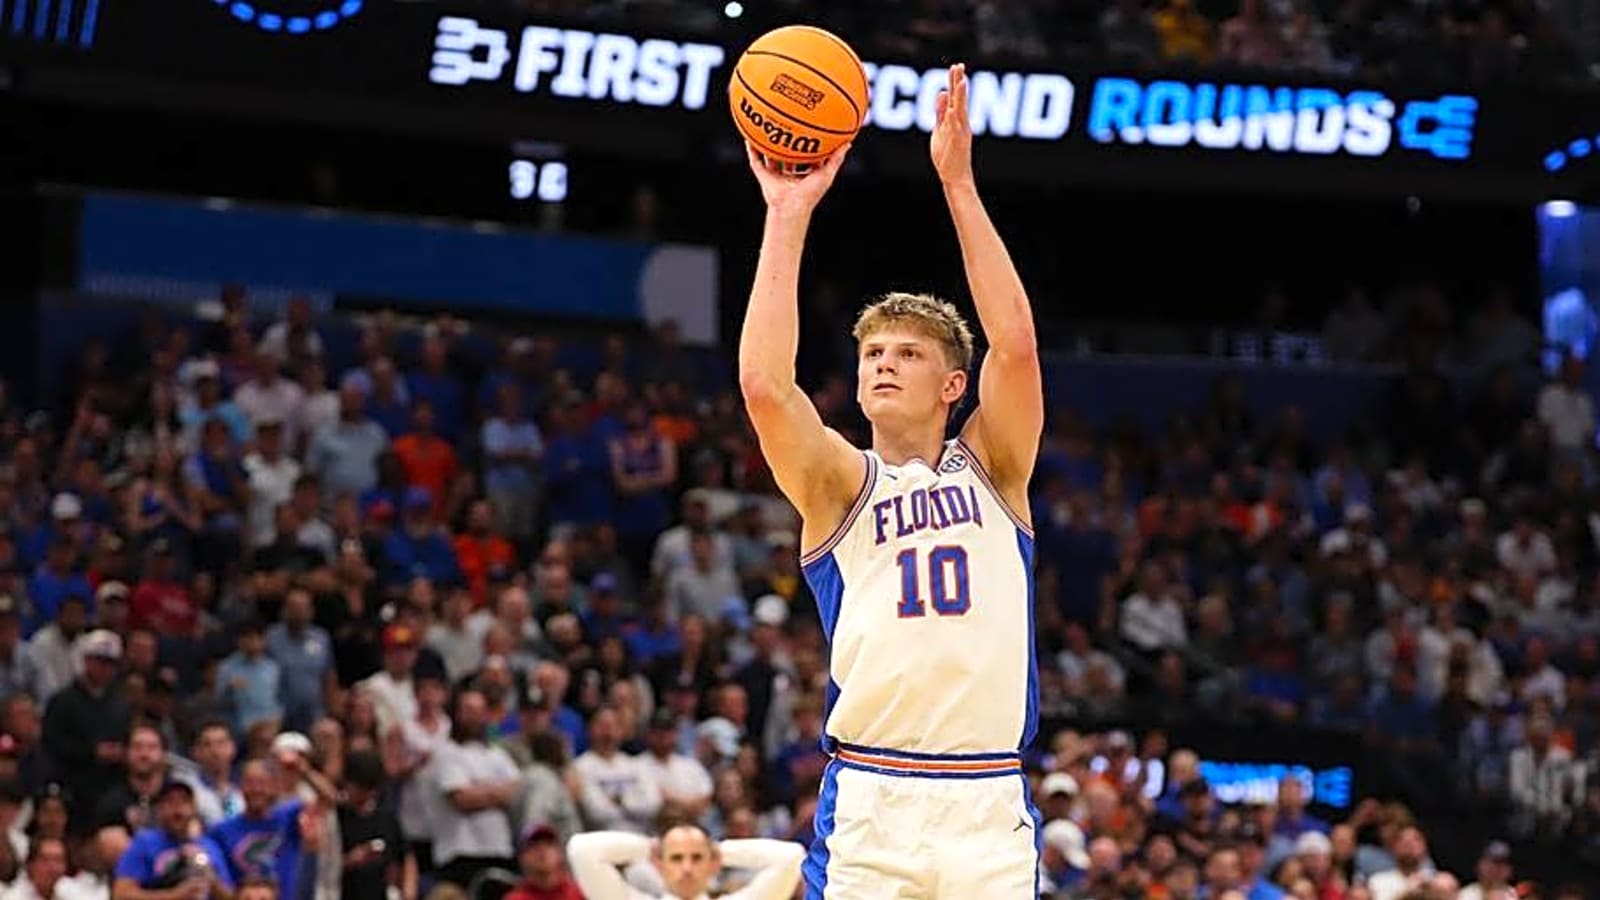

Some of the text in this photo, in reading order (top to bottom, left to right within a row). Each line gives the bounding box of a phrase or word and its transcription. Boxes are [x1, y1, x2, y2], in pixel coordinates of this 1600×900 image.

[514, 25, 725, 109] FIRST
[862, 61, 1074, 139] COND
[1087, 77, 1396, 156] ROUNDS
[740, 97, 821, 153] Wilson
[896, 545, 972, 619] 10
